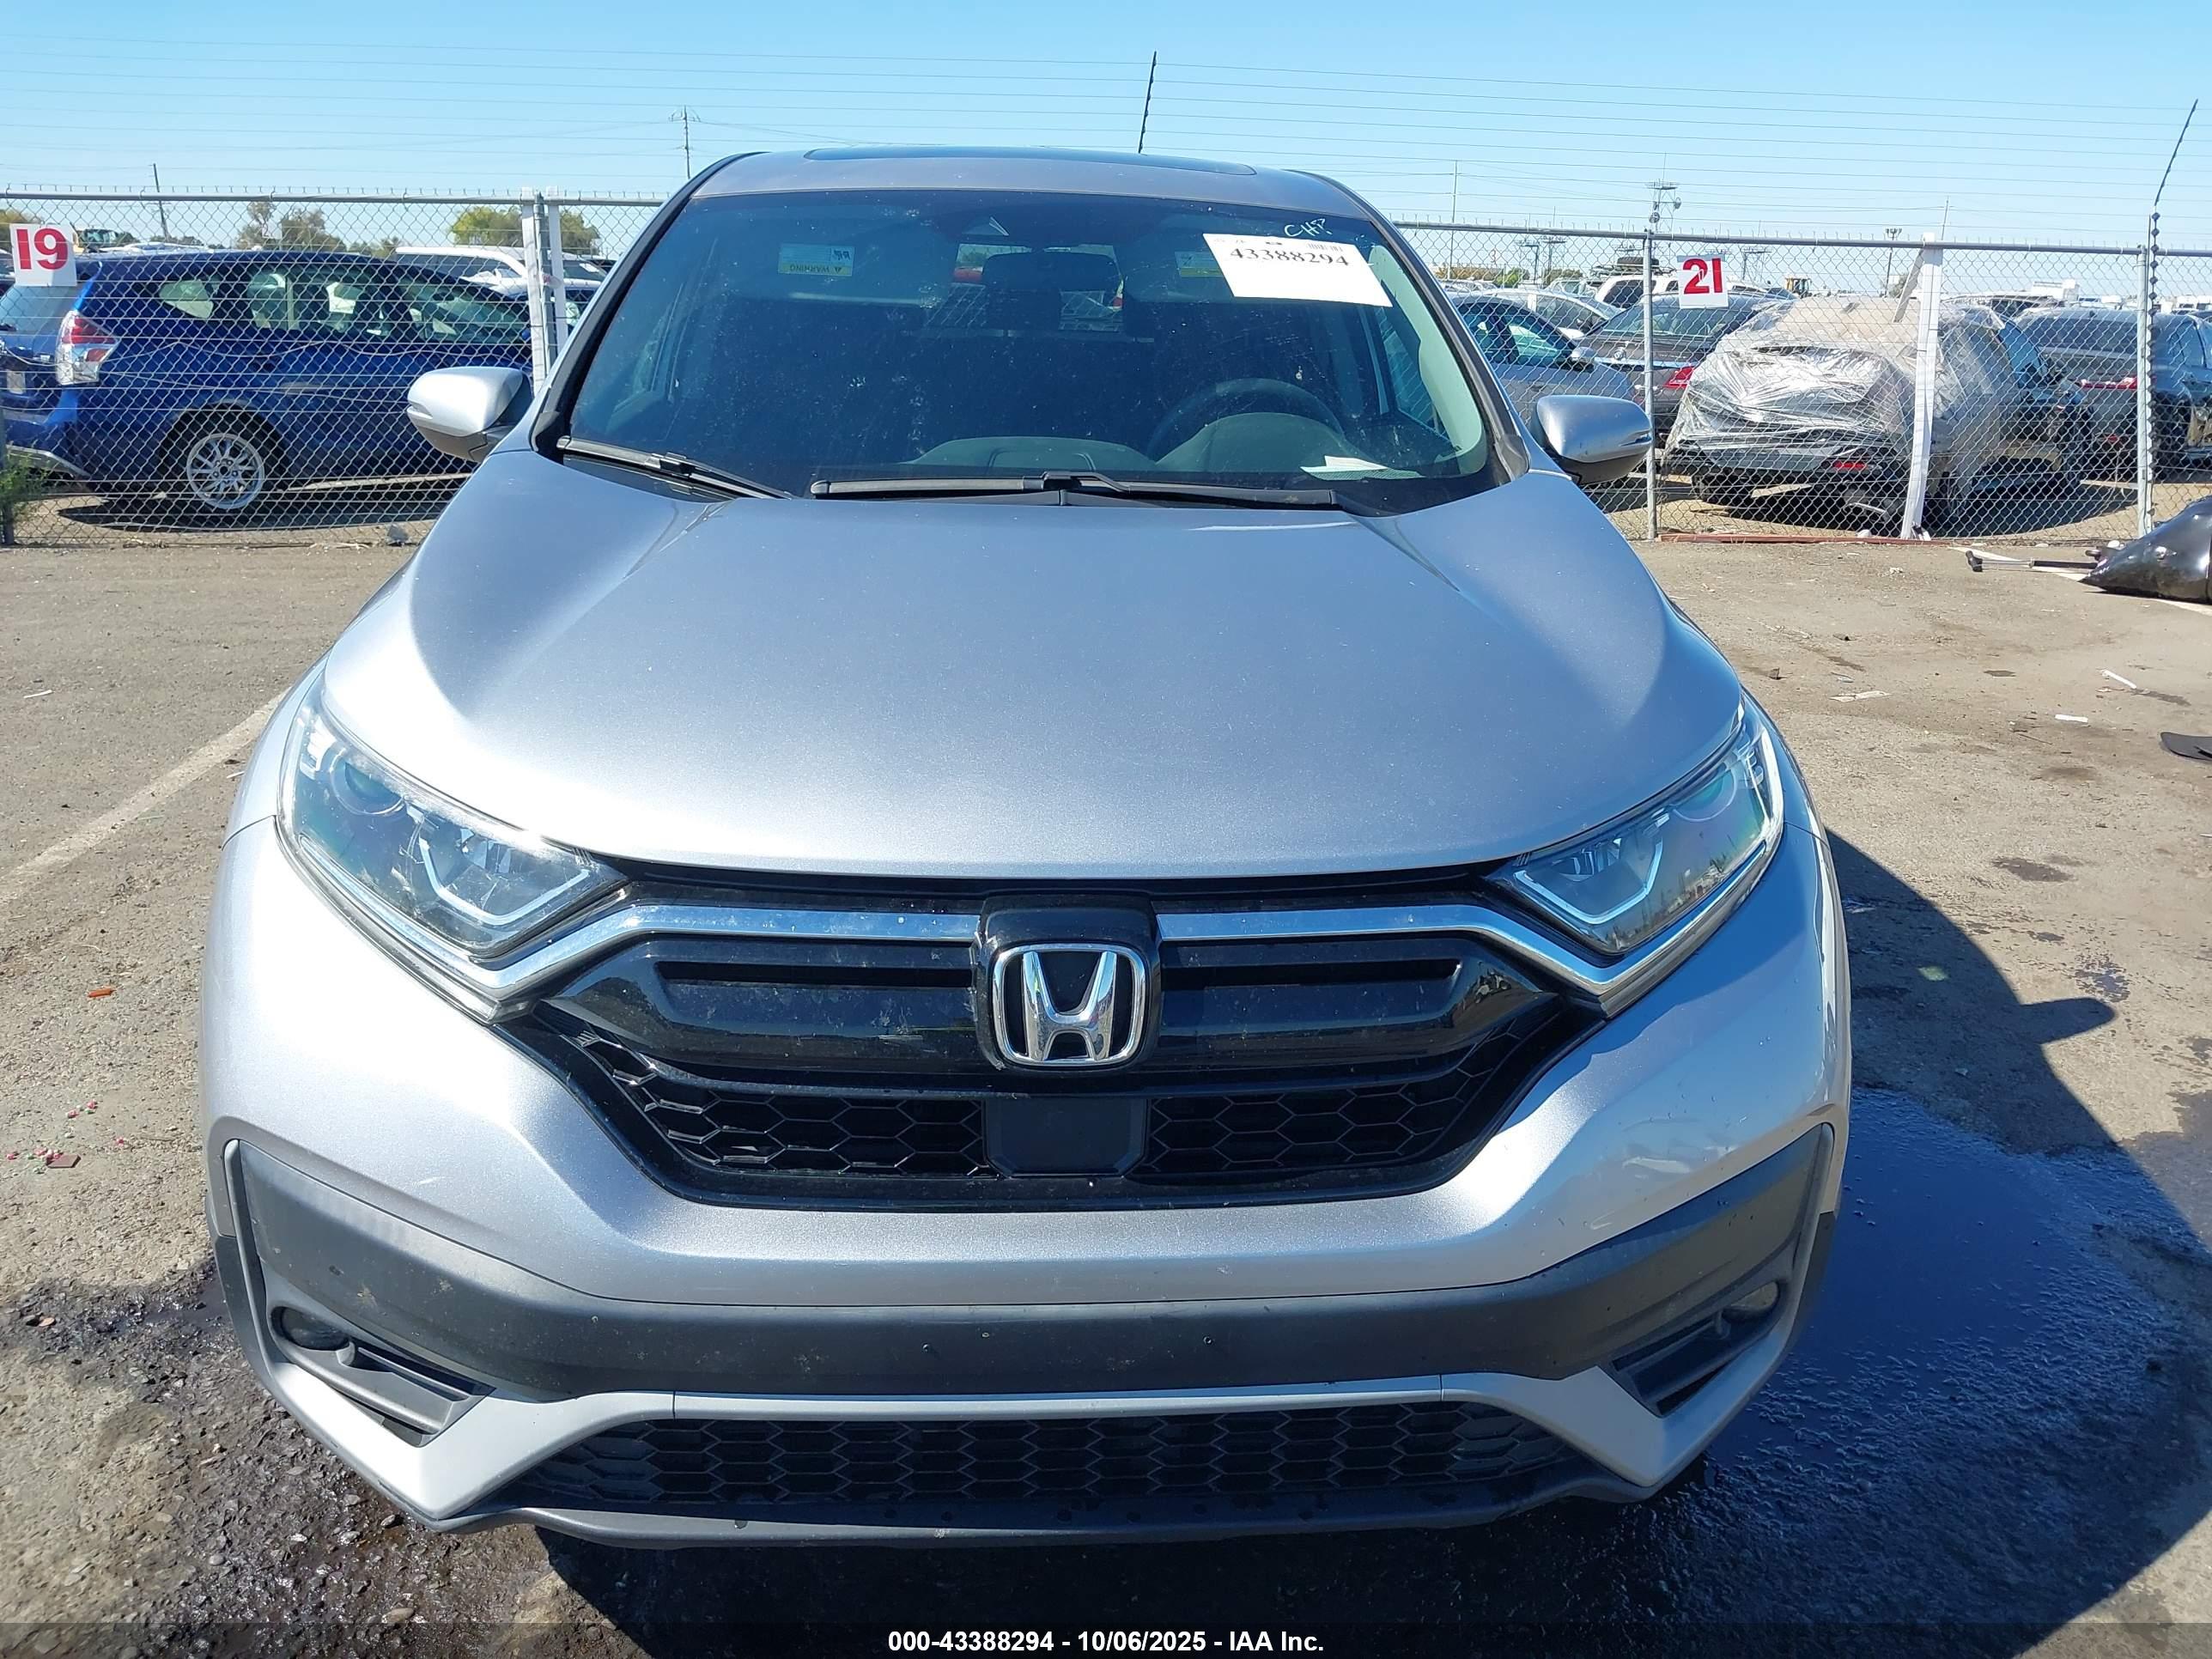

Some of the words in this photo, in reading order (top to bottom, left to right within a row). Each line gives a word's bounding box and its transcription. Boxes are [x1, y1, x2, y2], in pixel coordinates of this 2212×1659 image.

[16, 228, 68, 270] 19
[1230, 246, 1349, 266] 43388294
[1682, 258, 1723, 295] 21
